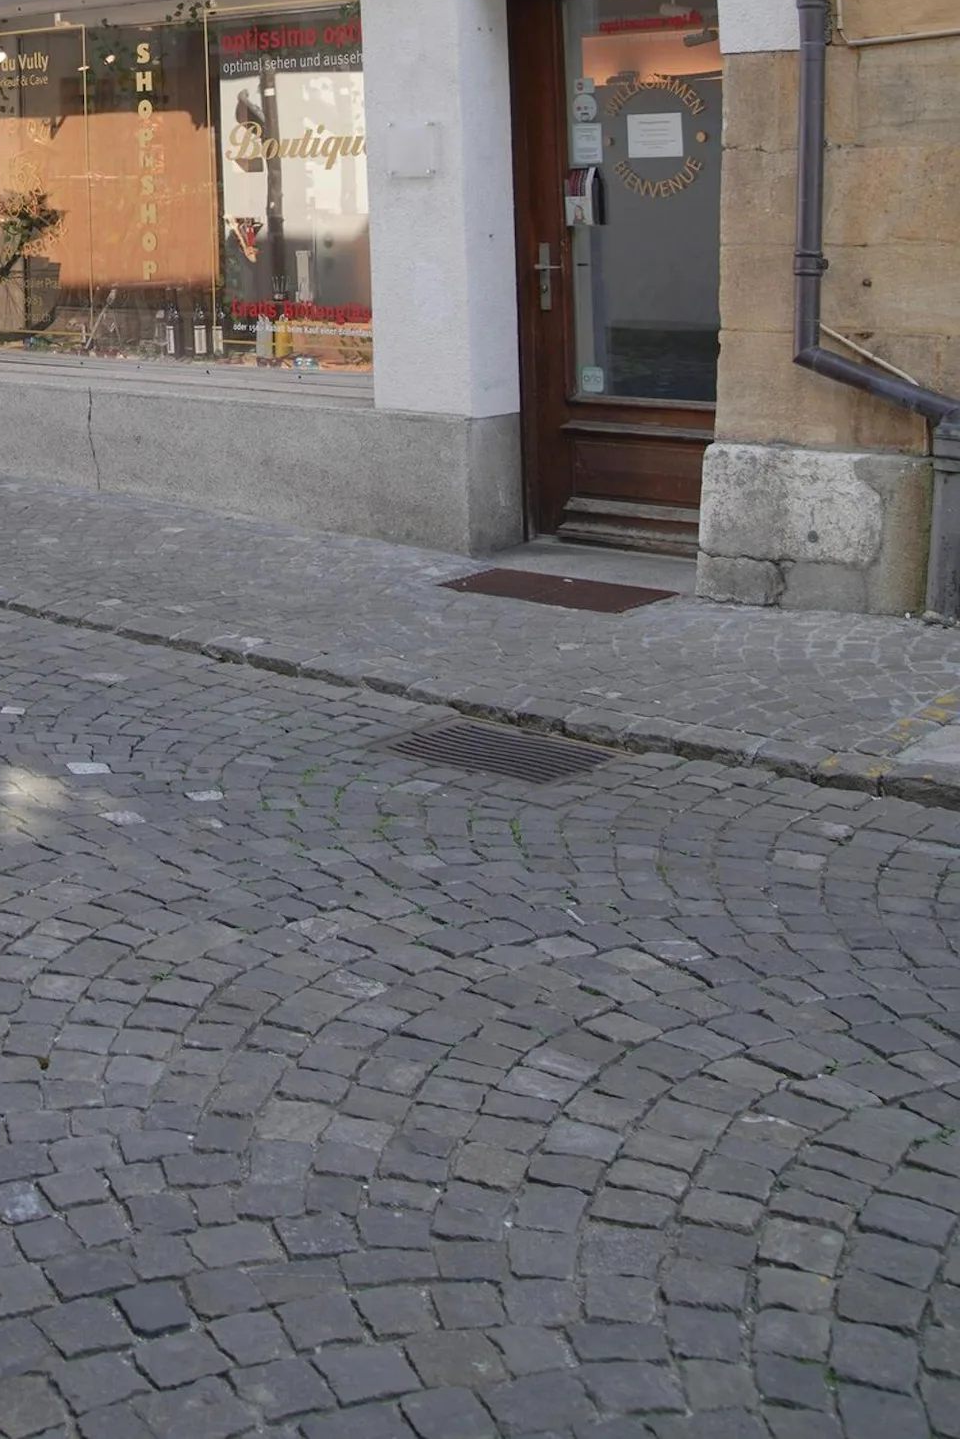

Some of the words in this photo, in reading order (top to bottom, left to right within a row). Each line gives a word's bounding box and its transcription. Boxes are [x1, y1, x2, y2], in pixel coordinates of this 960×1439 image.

[222, 23, 318, 58] optissimo
[18, 51, 49, 73] Vully
[223, 57, 263, 75] optimal
[265, 56, 297, 71] sehen
[299, 54, 321, 68] und
[30, 74, 49, 86] Cave
[605, 73, 705, 118] WILLKOMMEN
[225, 120, 368, 171] Boutiqu
[614, 156, 703, 199] BIENVENUE
[231, 297, 277, 318] Gratis
